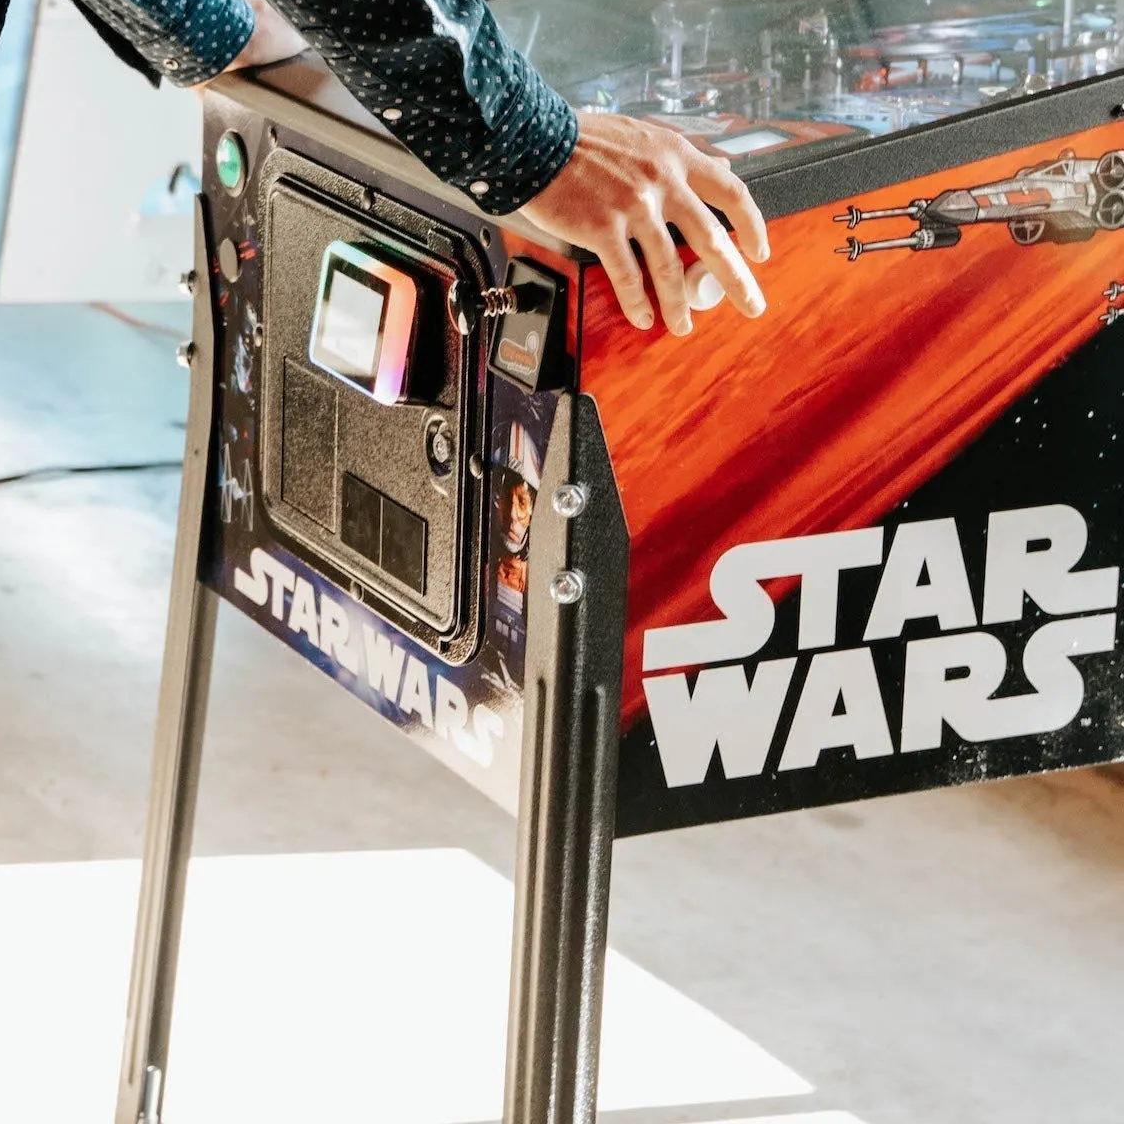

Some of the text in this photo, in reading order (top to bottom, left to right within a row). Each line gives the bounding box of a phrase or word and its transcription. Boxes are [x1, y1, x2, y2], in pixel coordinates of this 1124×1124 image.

[234, 547, 504, 768] STAR WARS
[642, 504, 1120, 672] STAR
[642, 613, 1117, 789] WARS
